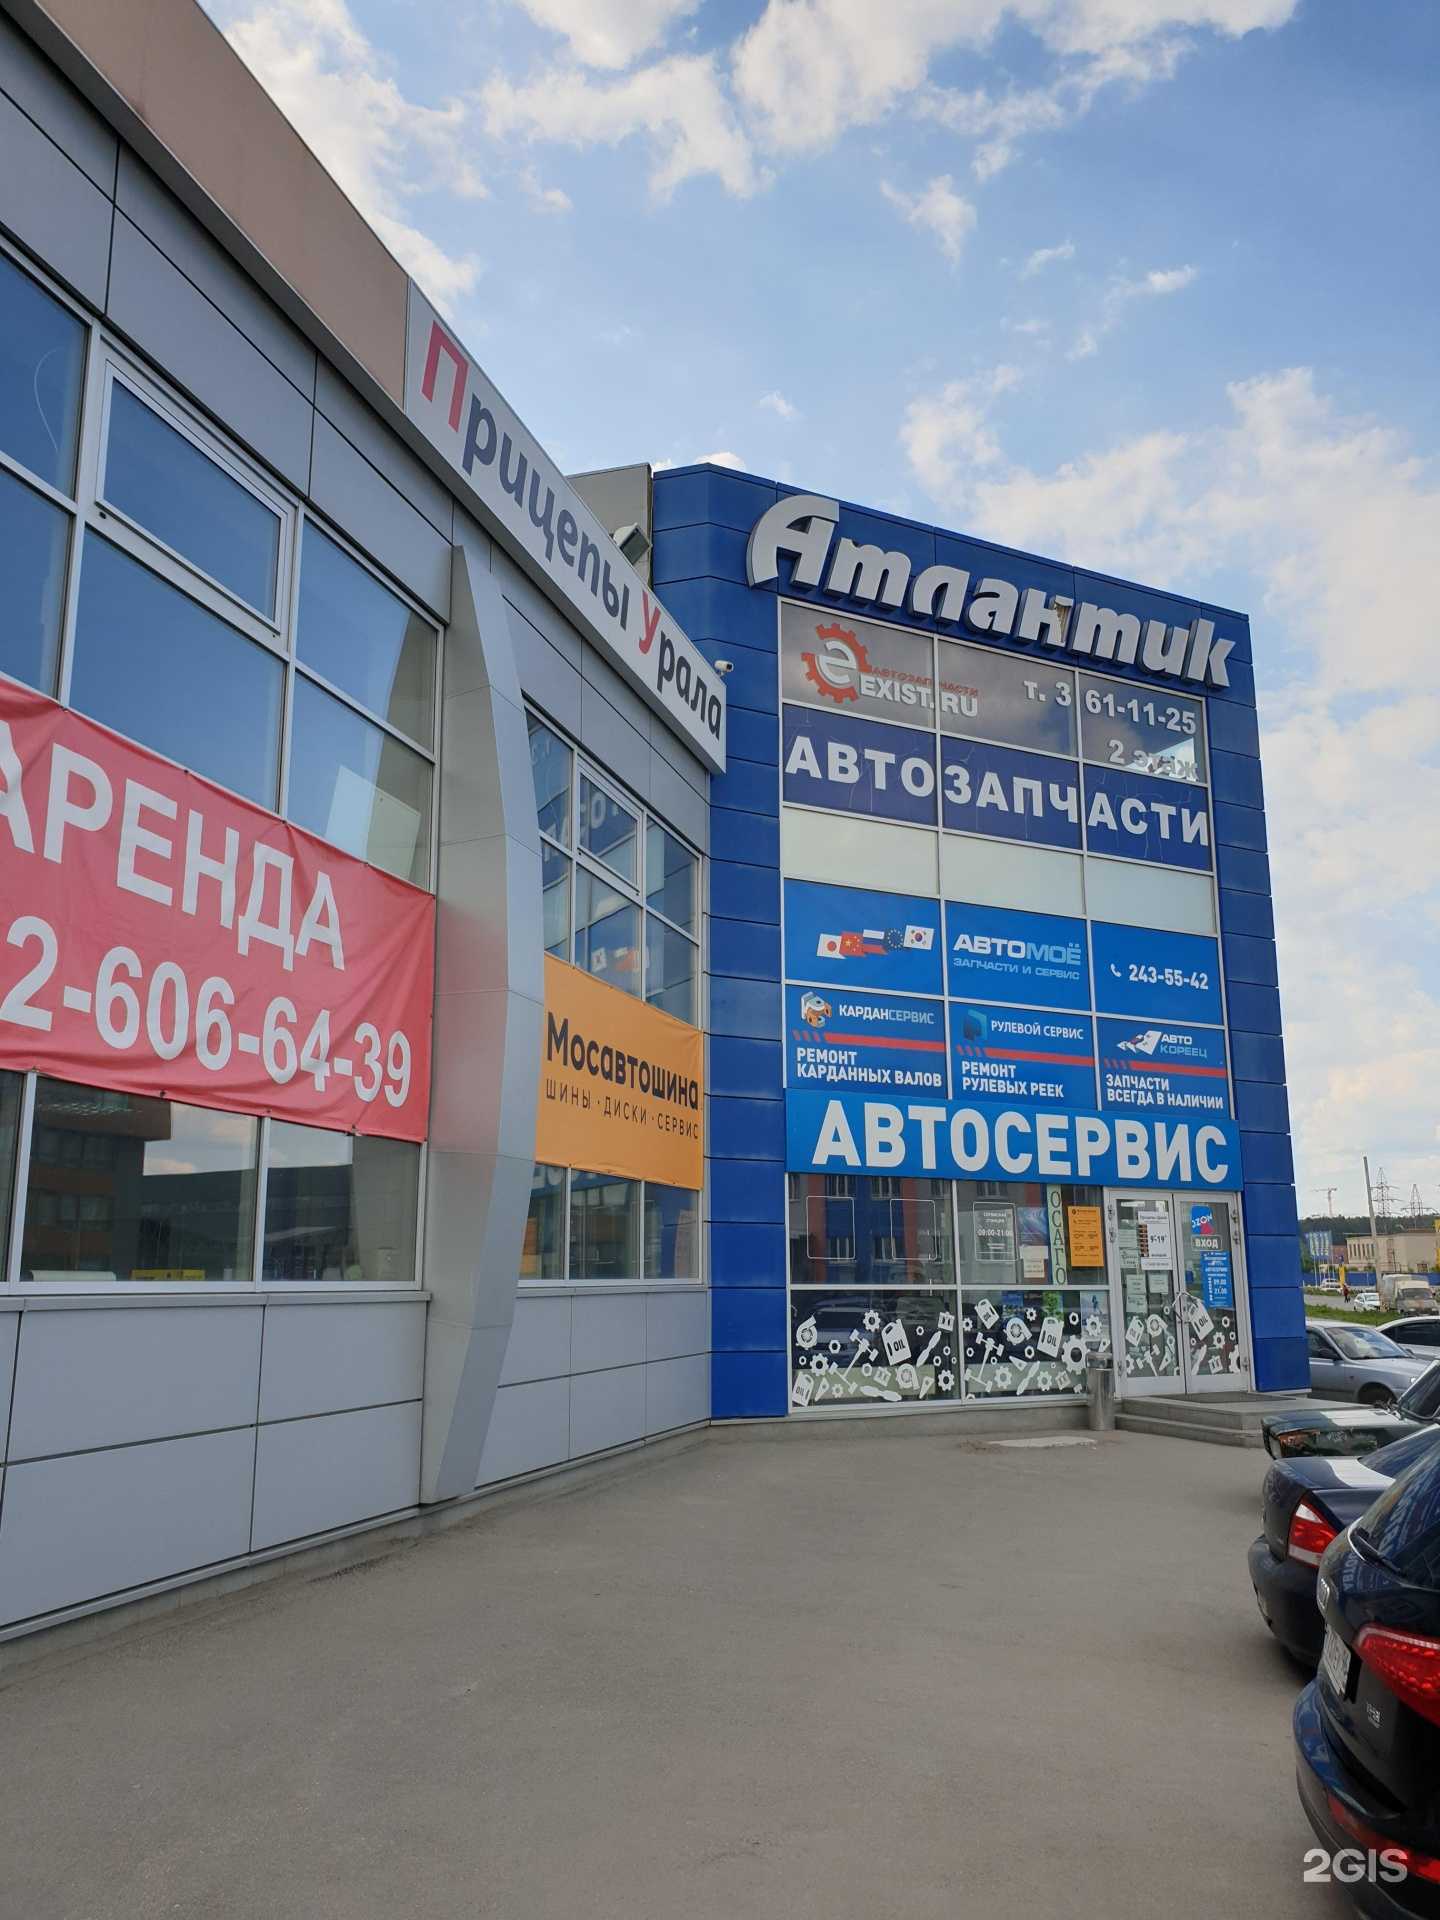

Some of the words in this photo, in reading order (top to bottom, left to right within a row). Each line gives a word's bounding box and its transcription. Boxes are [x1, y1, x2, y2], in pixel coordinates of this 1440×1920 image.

[421, 320, 629, 630] Прицепы
[638, 590, 722, 742] Урала
[746, 494, 1237, 688] Атлантик
[859, 673, 978, 717] EXIST.RU
[1108, 739, 1126, 764] 2
[785, 735, 1209, 847] АВТОЗАПЧАСТИ
[953, 934, 1082, 966] АВТОМОЁ
[953, 957, 1019, 974] ЗАПЧАСТИ
[1022, 965, 1032, 975] И
[1035, 967, 1080, 980] СЕРВИС
[1128, 963, 1209, 990] 243-55-42
[839, 1004, 935, 1025] КАРДАНСЕРВИС
[991, 1019, 1041, 1036] РУЛЕВОЙ
[1043, 1025, 1084, 1040] СЕРВИС
[1161, 1034, 1192, 1045] АВТО
[547, 1011, 699, 1110] Мосавтошина
[796, 1047, 858, 1065] РЕМОНТ
[1160, 1045, 1208, 1058] КОРЕЕЦ
[797, 1063, 892, 1083] КАРДАННЫХ
[894, 1070, 942, 1087] ВАЛОВ
[961, 1060, 1016, 1078] РЕМОНТ
[962, 1077, 1027, 1095] РУЛЕВЫХ
[1030, 1082, 1064, 1097] РЕЕК
[1106, 1073, 1170, 1091] ЗАПЧАСТИ
[546, 1078, 591, 1110] ШИНЫ
[603, 1096, 647, 1125] ДИСКИ
[657, 1113, 699, 1140] СЕРВИС
[1107, 1088, 1155, 1106] ВСЕГДА
[1156, 1093, 1165, 1105] В
[1167, 1093, 1224, 1109] НАЛИЧИИ
[812, 1100, 1229, 1184] АВТОСЕРВИС
[1050, 1191, 1066, 1285] ОСАГО
[1194, 1238, 1219, 1249] ВХОД
[893, 1339, 906, 1351] OIL
[1047, 1334, 1057, 1347] OIL
